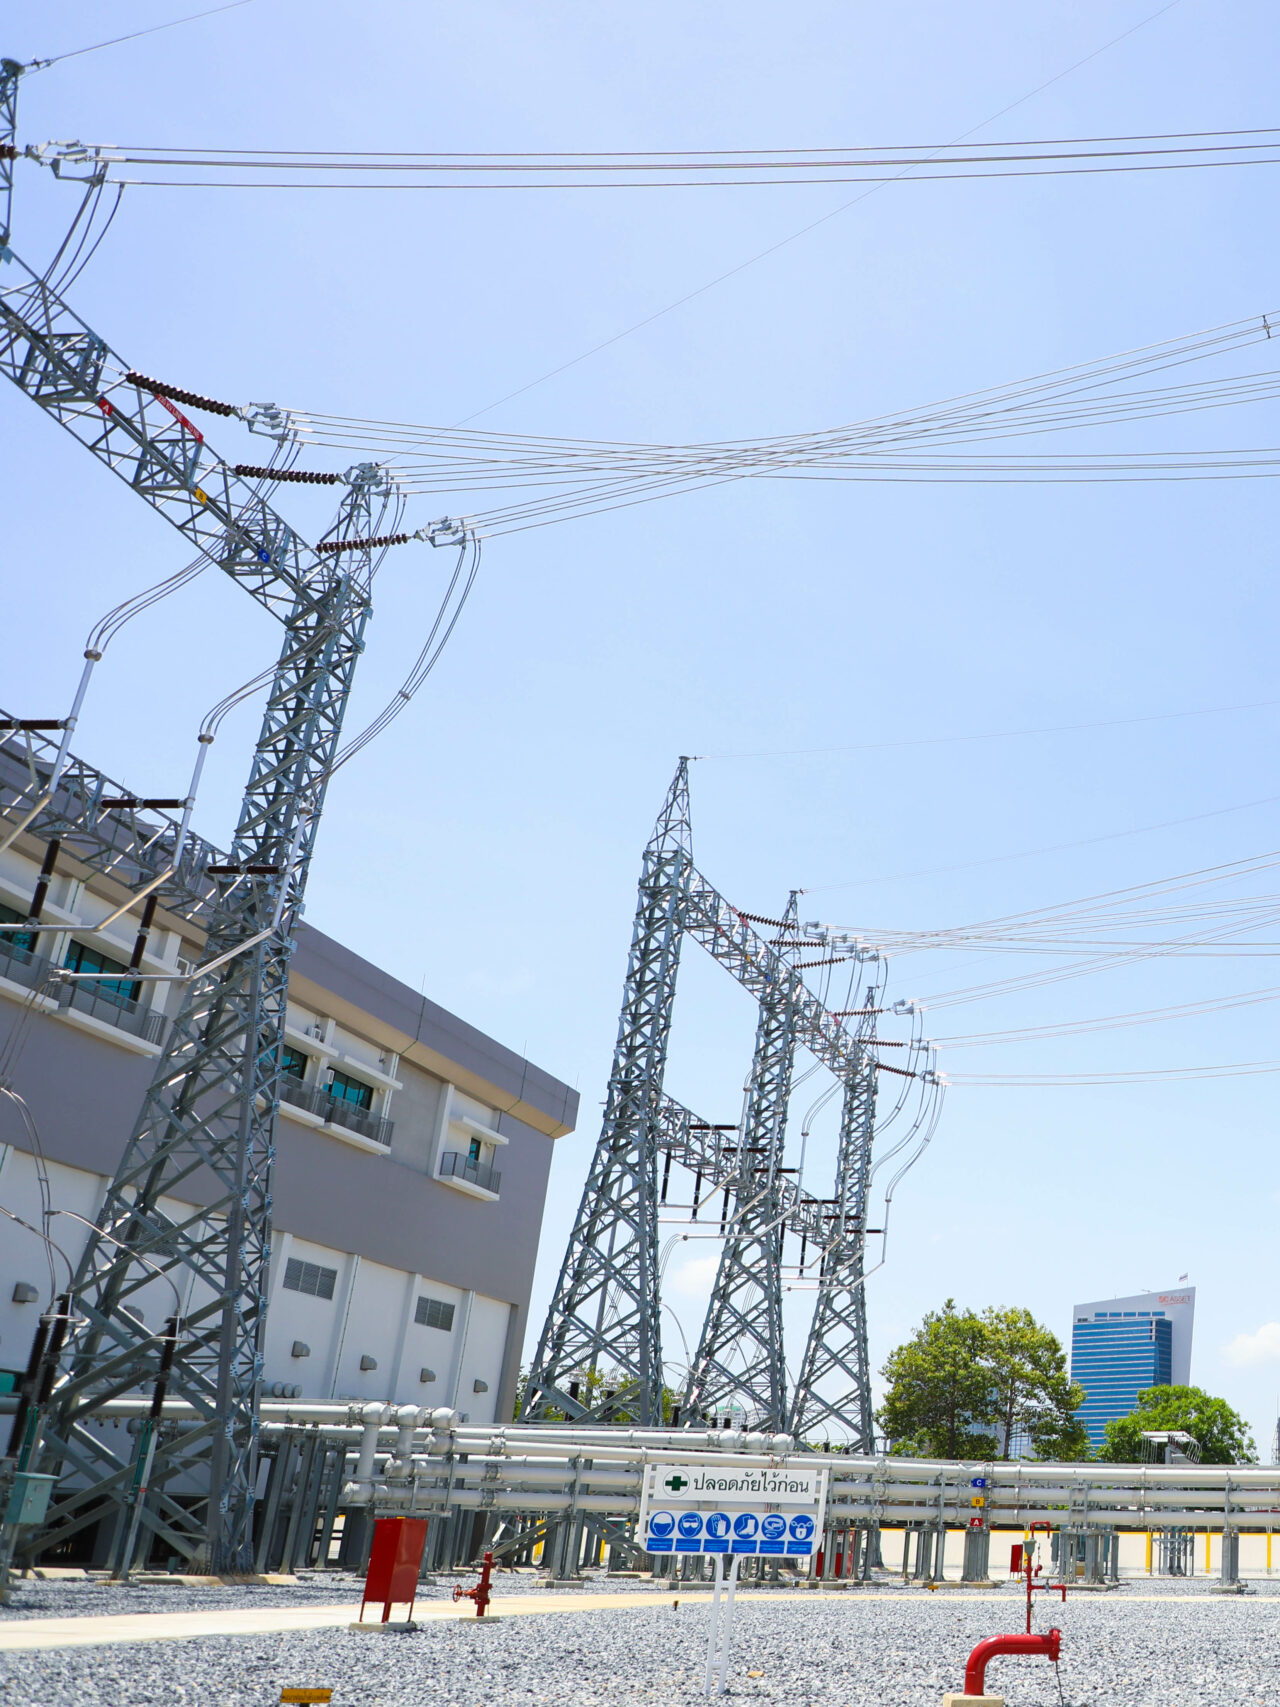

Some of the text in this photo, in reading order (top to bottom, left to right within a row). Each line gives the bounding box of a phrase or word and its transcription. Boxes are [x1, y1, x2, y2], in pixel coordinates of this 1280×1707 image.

[693, 1470, 809, 1493] ปลอดภัยไว้ก่อน
